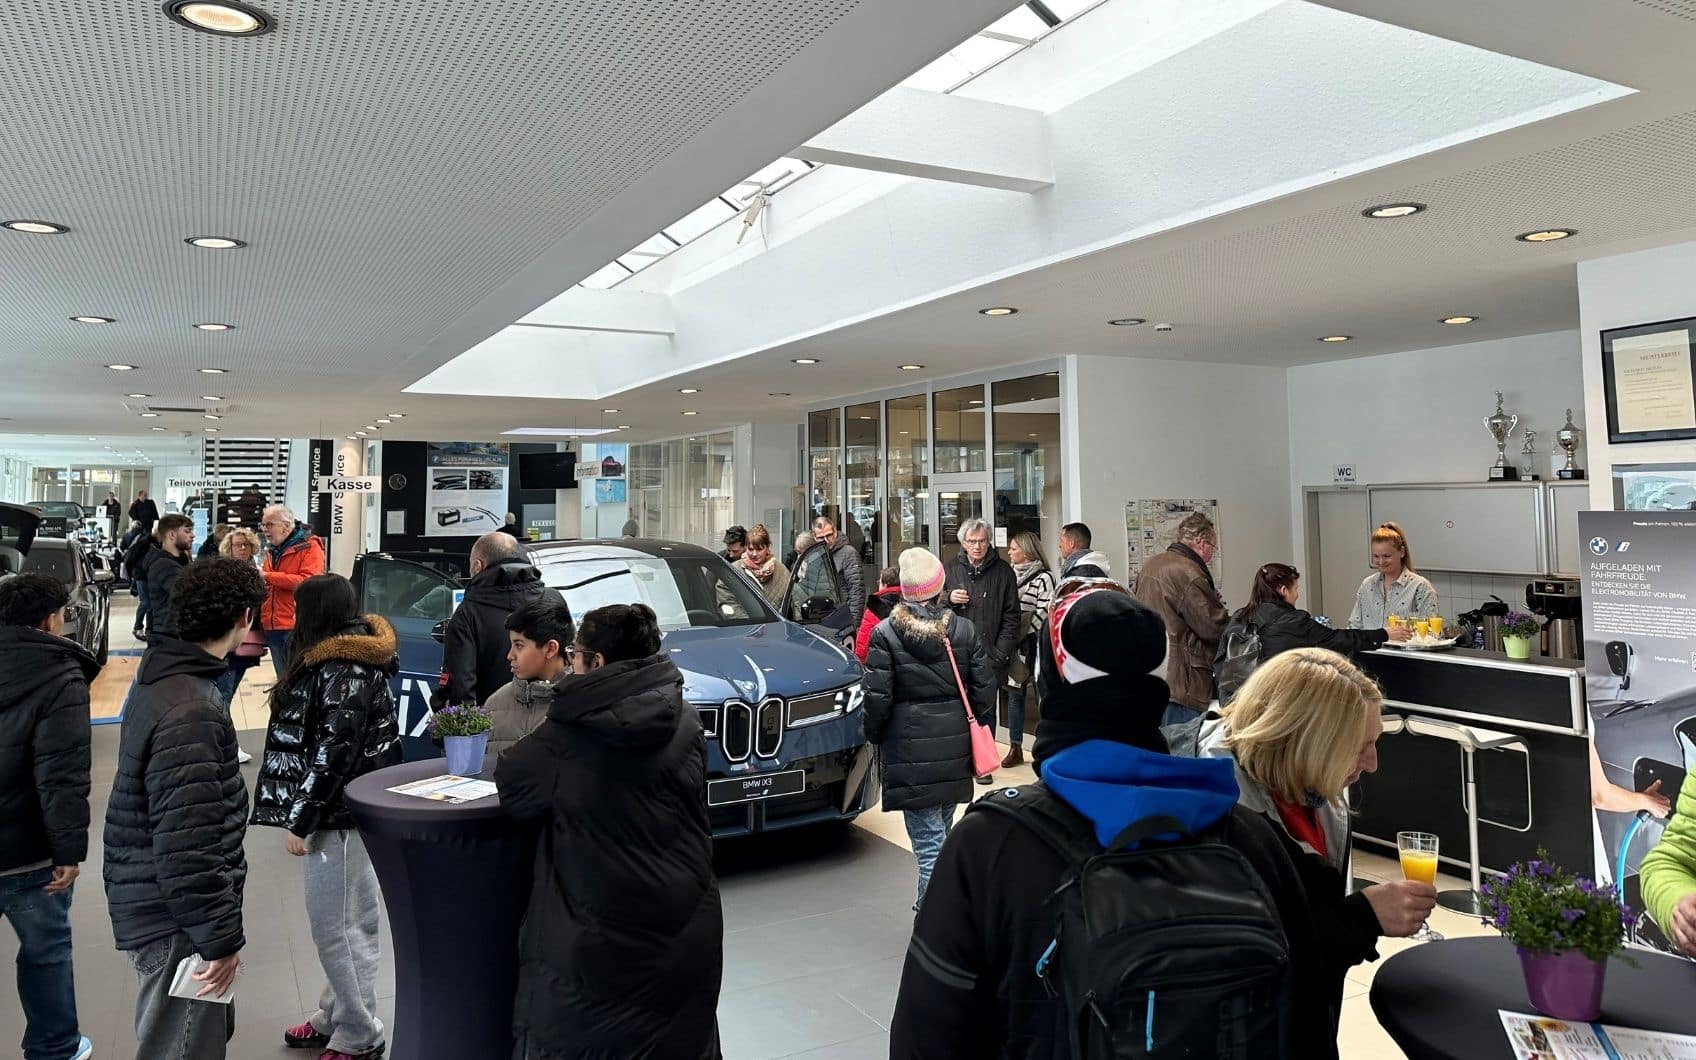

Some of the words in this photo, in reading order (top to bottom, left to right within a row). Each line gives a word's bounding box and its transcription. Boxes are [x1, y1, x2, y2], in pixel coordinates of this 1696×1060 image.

[312, 448, 320, 486] Service
[1337, 467, 1352, 476] WC
[335, 454, 345, 499] Svice
[169, 479, 227, 487] Teileverkauf
[327, 478, 372, 490] Kasse
[311, 490, 319, 513] MINI
[334, 505, 343, 534] BMW
[1590, 562, 1645, 572] AUFGELADEN
[1646, 565, 1662, 573] MIT
[1591, 571, 1647, 581] FAHRFREUDE.
[1591, 581, 1628, 589] ENTDECKEN
[1591, 588, 1652, 597] ELEKTROMOBILITÄT
[1668, 592, 1688, 600] BMW.
[742, 780, 760, 789] BMW
[761, 778, 772, 786] iX3
